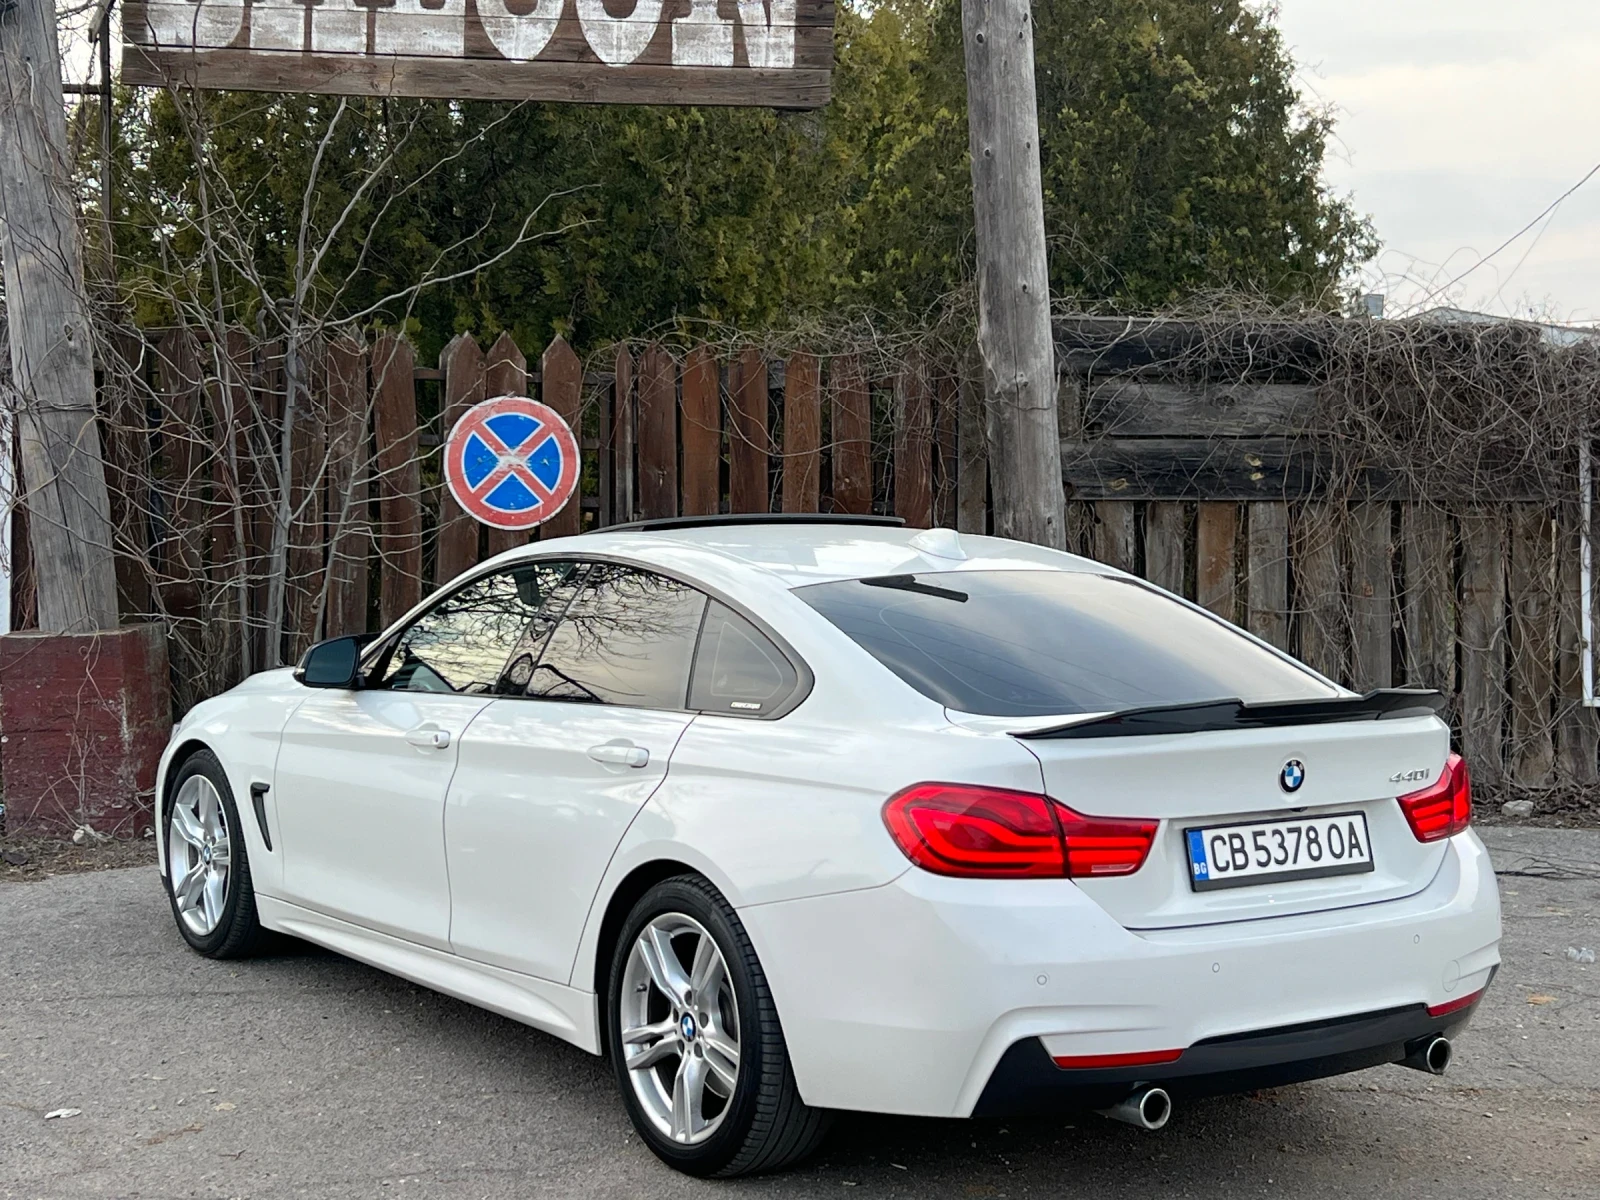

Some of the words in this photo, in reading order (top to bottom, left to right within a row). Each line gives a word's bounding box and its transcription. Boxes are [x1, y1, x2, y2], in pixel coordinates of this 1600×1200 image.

[1210, 833, 1249, 872] CB
[1252, 825, 1323, 868] 5378
[1327, 822, 1364, 859] OA
[1193, 862, 1207, 875] BG
